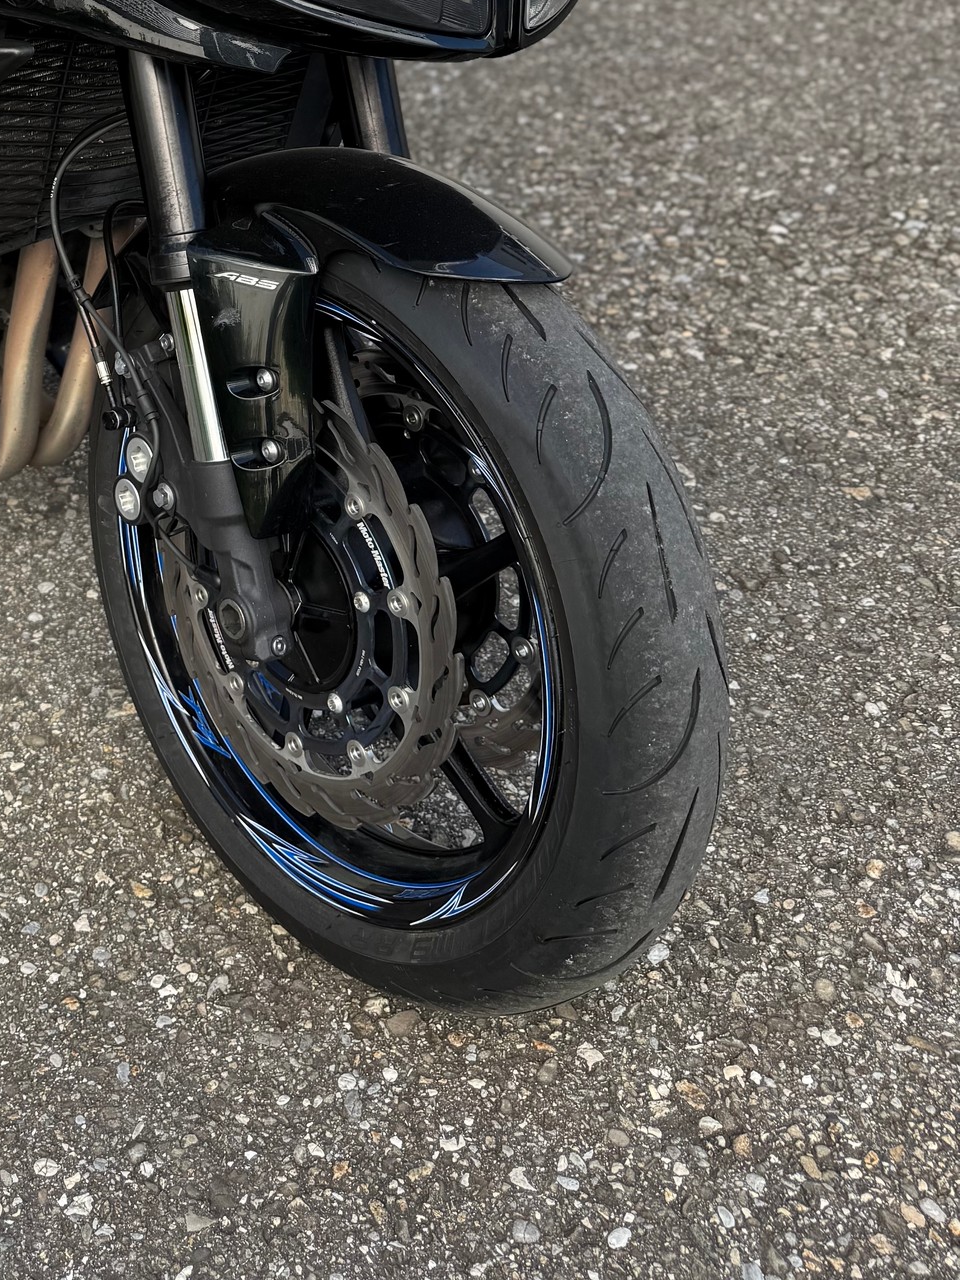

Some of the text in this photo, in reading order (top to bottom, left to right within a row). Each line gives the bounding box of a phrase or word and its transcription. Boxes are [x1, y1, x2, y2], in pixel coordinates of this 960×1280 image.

[212, 271, 280, 290] ABS
[356, 521, 392, 590] Moto-Master
[206, 607, 235, 669] Moto-Master
